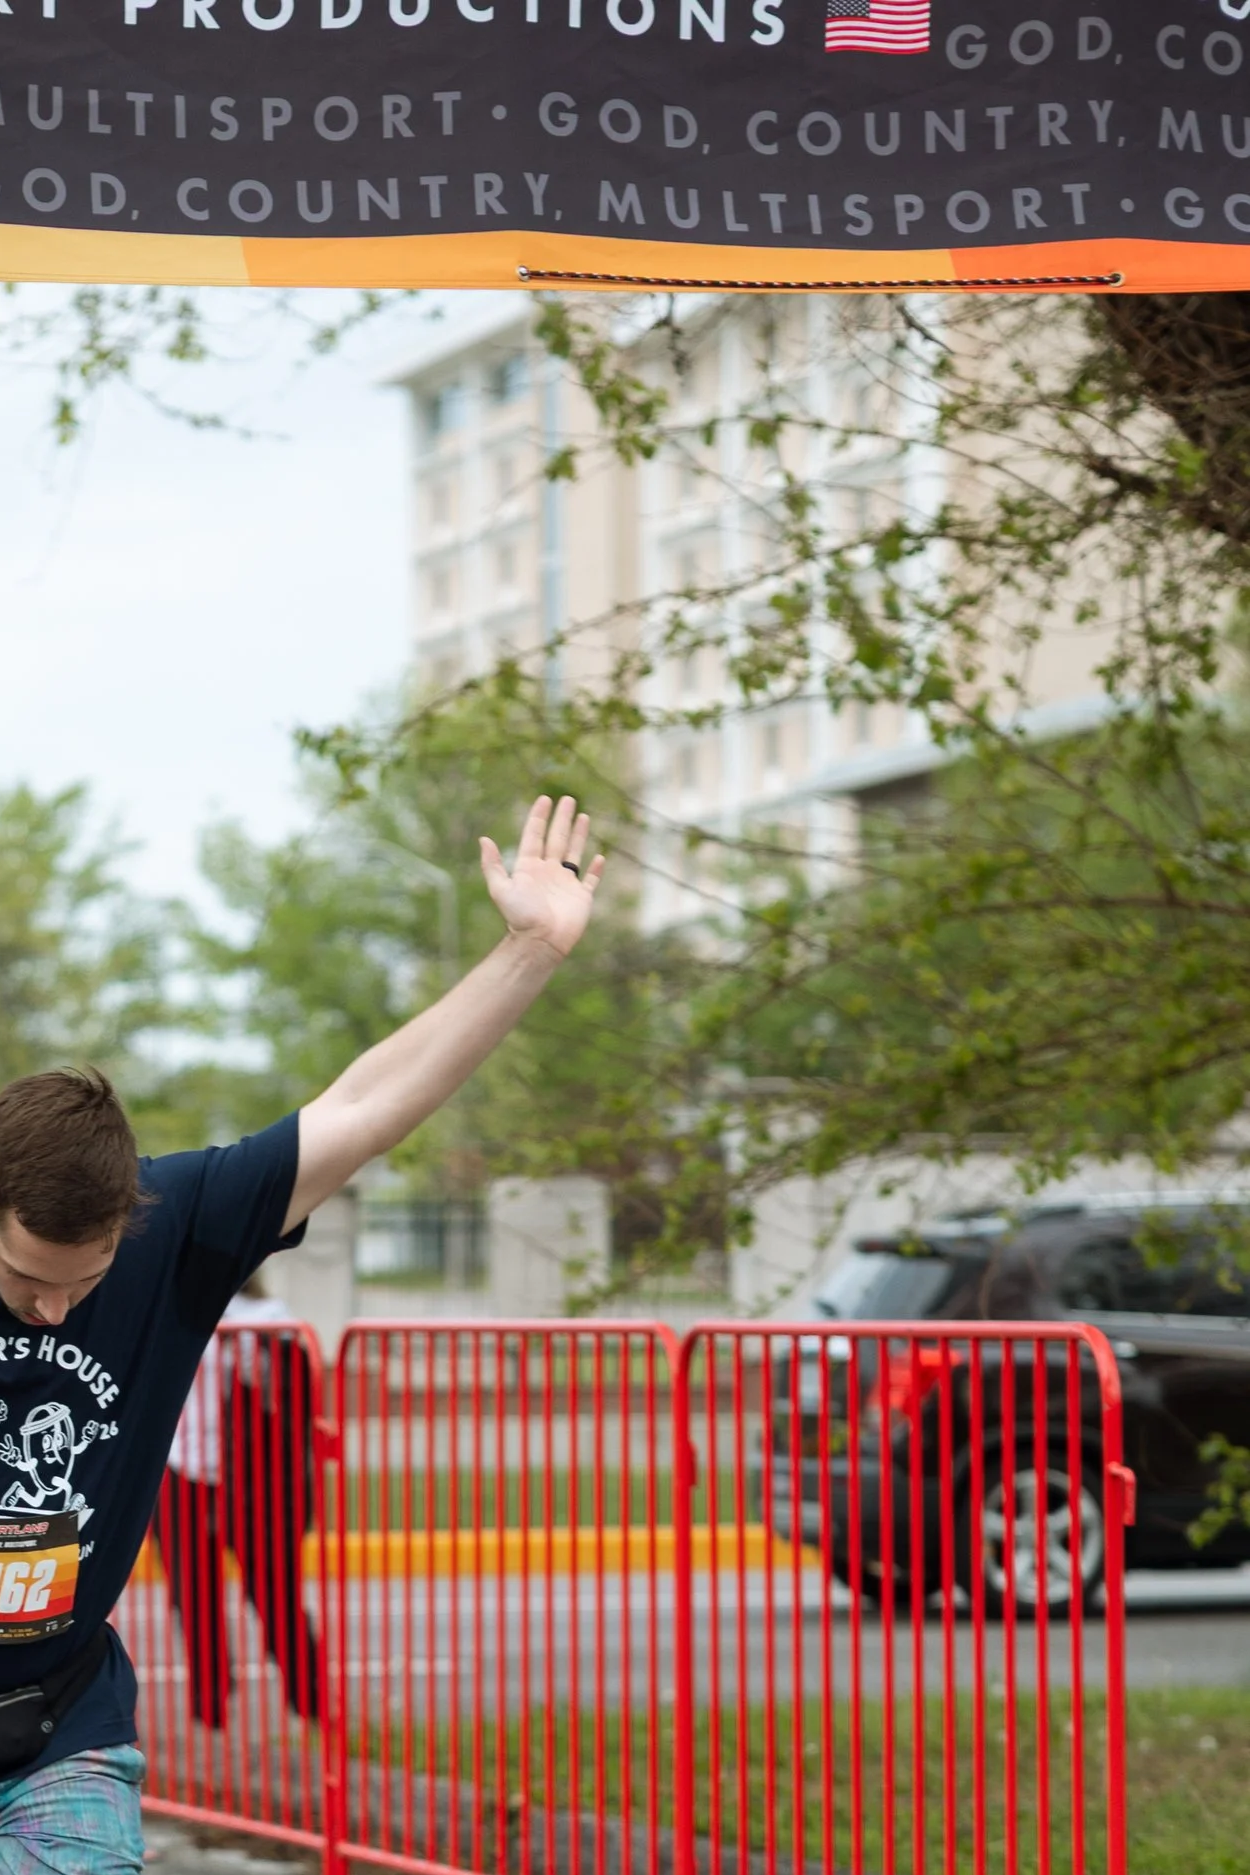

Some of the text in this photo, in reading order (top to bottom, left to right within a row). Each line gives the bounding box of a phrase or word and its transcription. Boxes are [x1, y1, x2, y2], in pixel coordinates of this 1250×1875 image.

[946, 16, 1123, 70] GOD,
[538, 91, 711, 155] GOD,
[746, 99, 1126, 156] COUNTRY,
[176, 171, 563, 224] COUNTRY,
[597, 180, 1091, 237] MULTISPORT
[37, 1335, 120, 1410] HOUSE
[99, 1420, 120, 1441] 26
